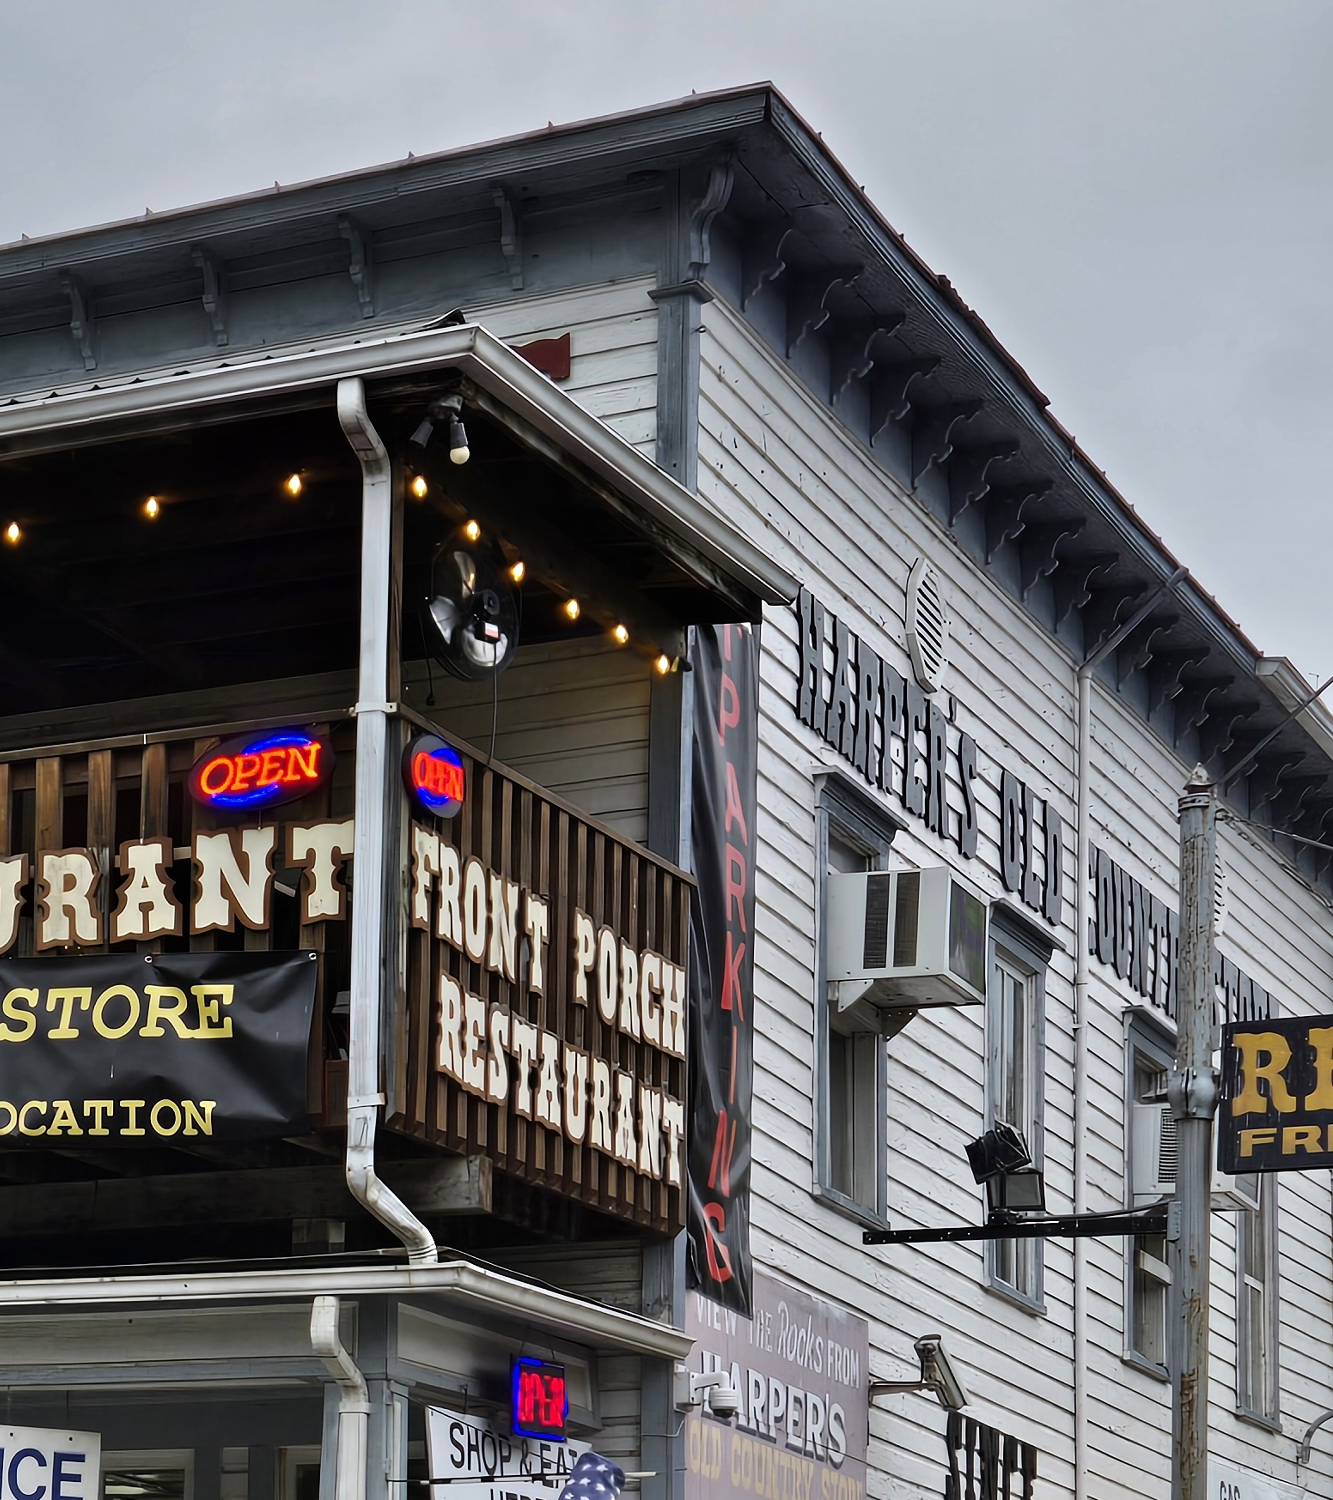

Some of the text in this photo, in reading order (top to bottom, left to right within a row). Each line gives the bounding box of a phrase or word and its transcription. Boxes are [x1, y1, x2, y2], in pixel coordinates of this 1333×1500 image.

[200, 742, 322, 797] OPEN
[797, 586, 977, 860] HARPER'S
[1001, 769, 1062, 926] OLD
[411, 823, 685, 1061] FRONT PORCH
[702, 672, 748, 1282] PARKING
[439, 973, 684, 1188] RESTAURANT
[701, 1351, 847, 1469] HARPER'S
[828, 1340, 860, 1388] FROM
[450, 1422, 511, 1476] SHOP
[690, 1419, 721, 1480] OLD
